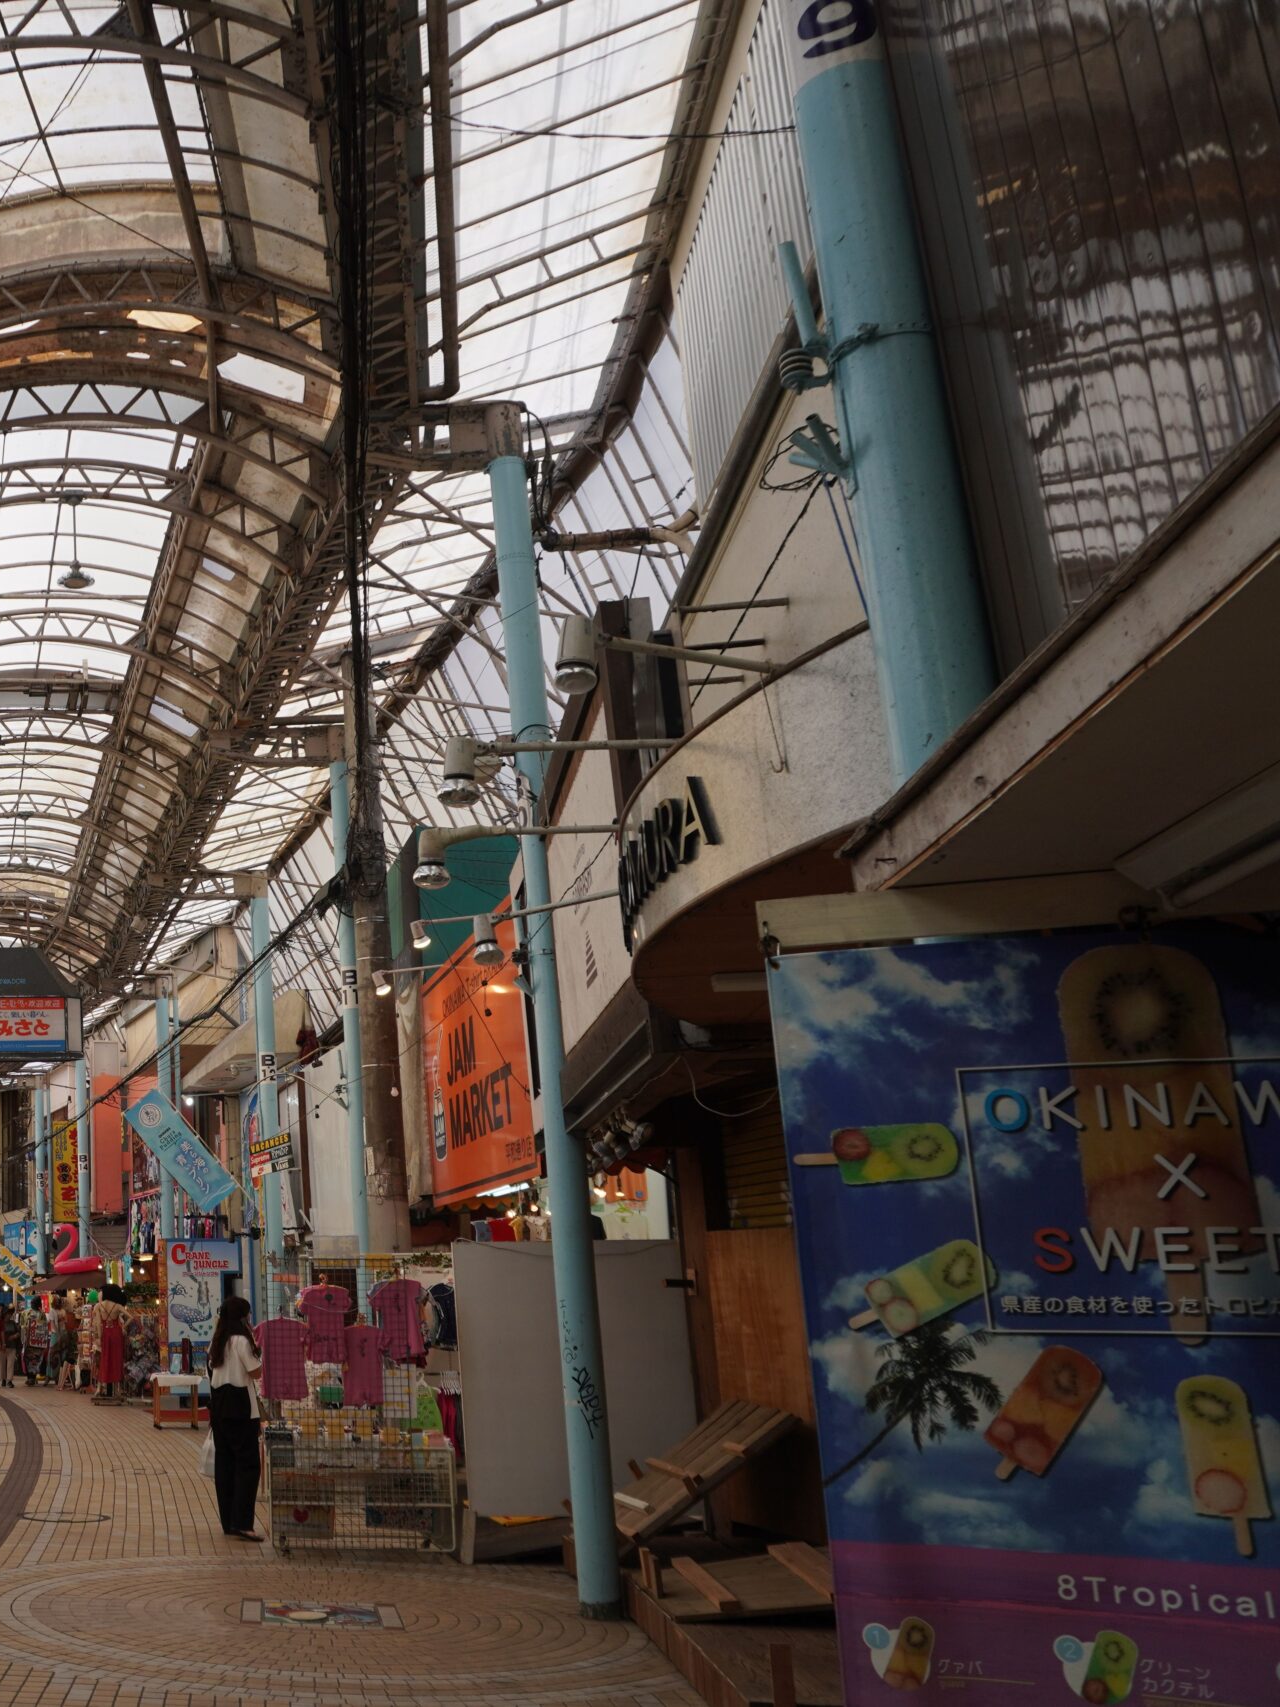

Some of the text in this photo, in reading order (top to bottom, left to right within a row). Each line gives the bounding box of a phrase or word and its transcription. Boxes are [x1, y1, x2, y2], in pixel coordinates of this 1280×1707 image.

[342, 969, 358, 986] B
[343, 989, 359, 1005] 11
[261, 1054, 275, 1066] B
[447, 1015, 477, 1087] JAM
[448, 1062, 513, 1149] MARKET
[250, 1133, 289, 1153] VACANCES
[79, 1154, 88, 1162] B
[171, 1243, 210, 1265] CRANE
[193, 1260, 228, 1270] JUNGLE
[1056, 1573, 1276, 1620] 8Tropical
[1063, 1643, 1078, 1658] 2
[1140, 1658, 1211, 1679] グリーン
[1142, 1678, 1215, 1699] カクテル
